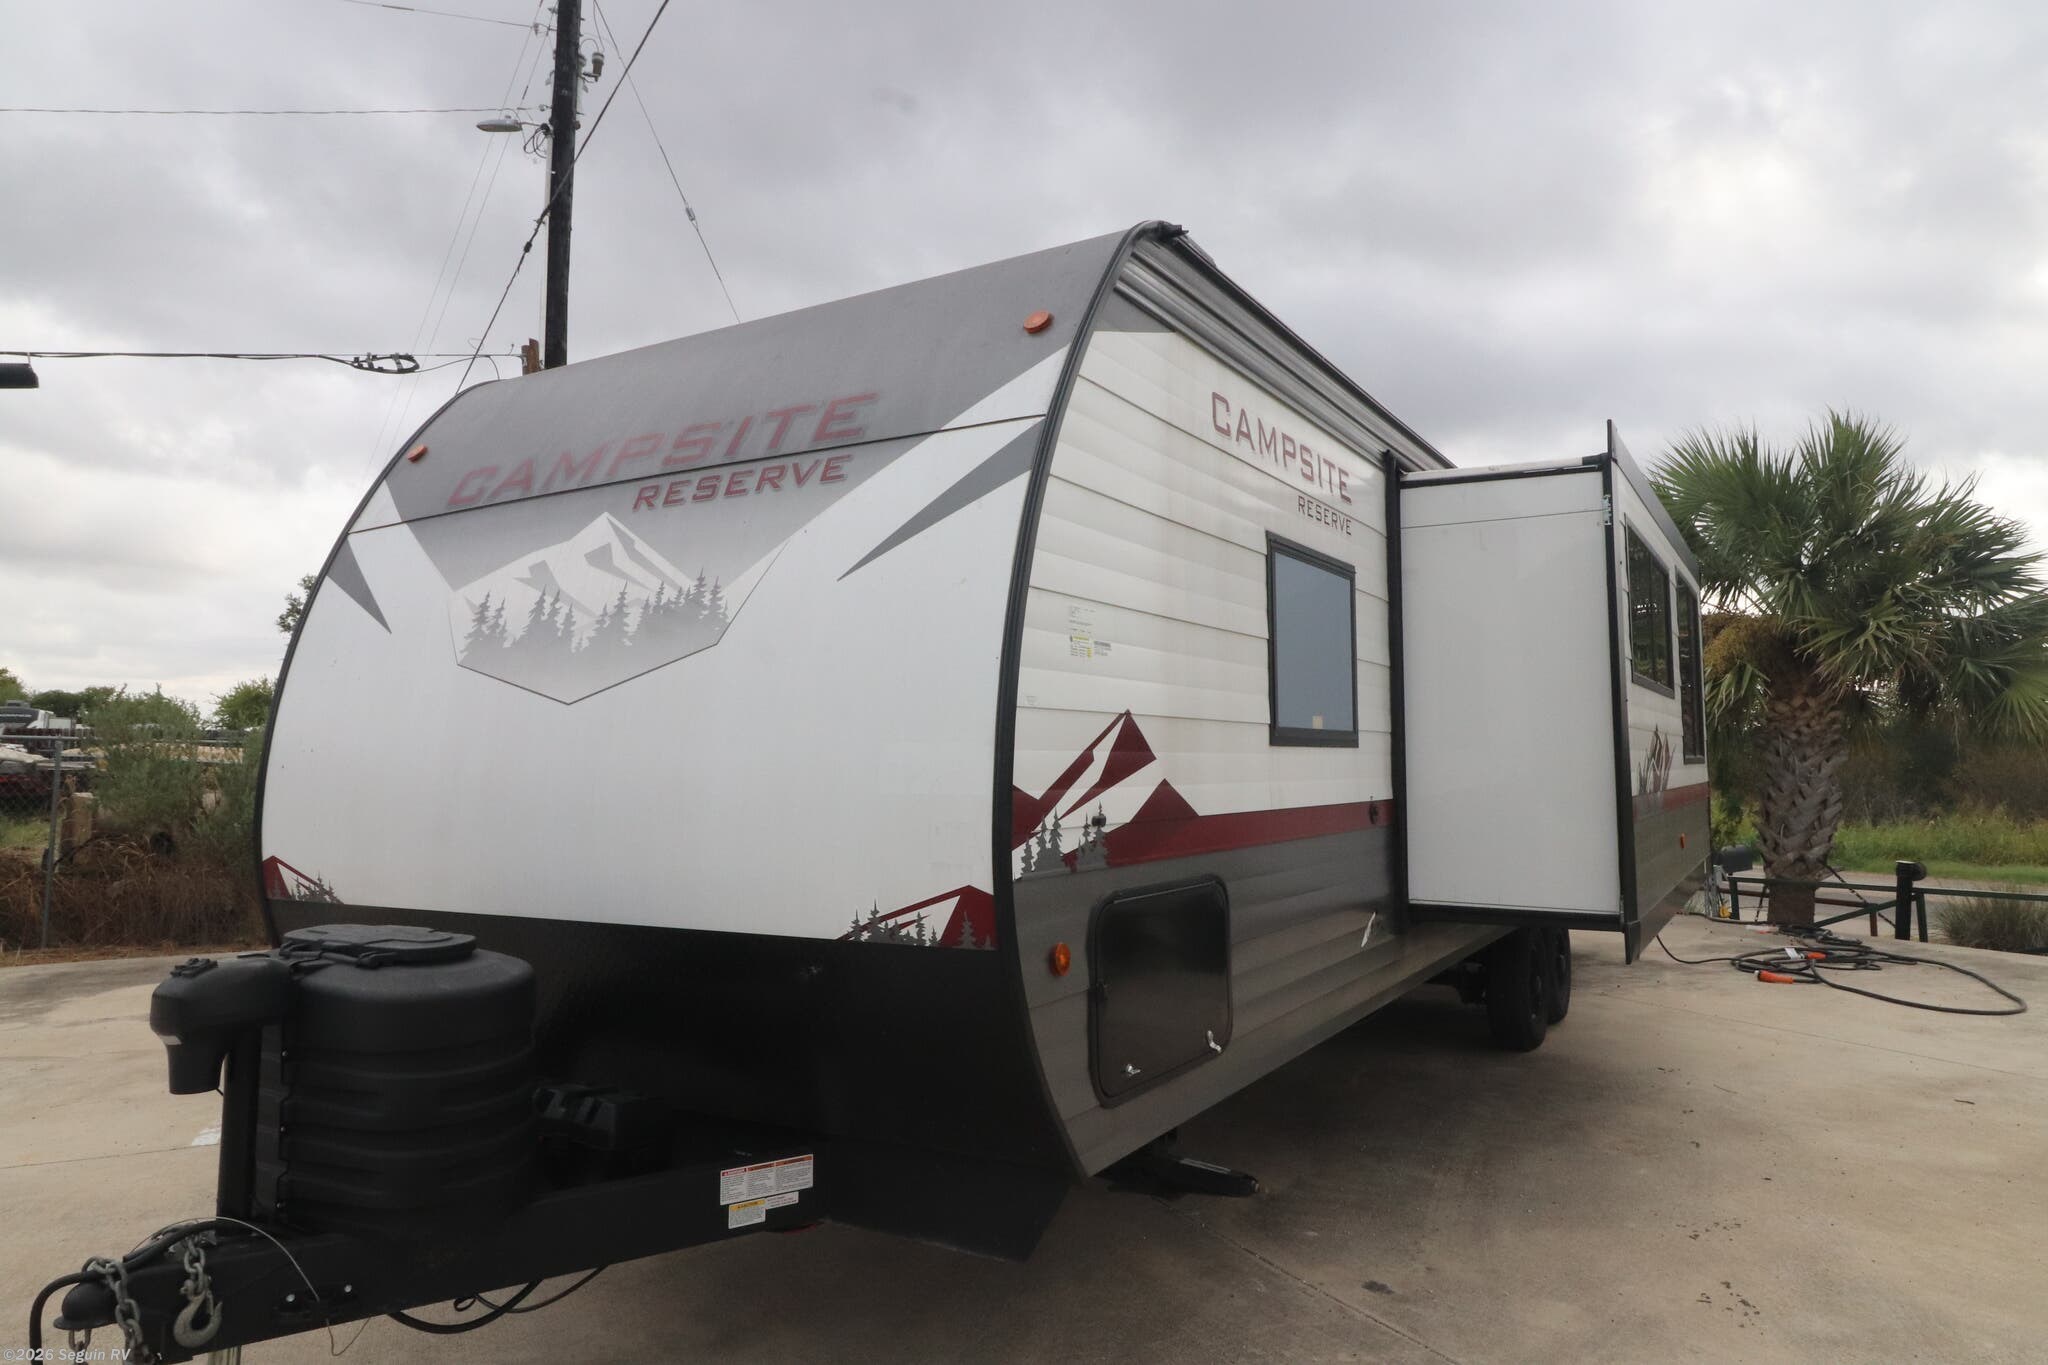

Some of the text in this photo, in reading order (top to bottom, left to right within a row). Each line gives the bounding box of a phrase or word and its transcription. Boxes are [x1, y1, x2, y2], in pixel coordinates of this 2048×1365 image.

[447, 393, 879, 507] CAMPSITE
[632, 454, 852, 512] RESERVE
[1211, 391, 1352, 505] CAMPSITE
[1297, 495, 1352, 536] RESERVE
